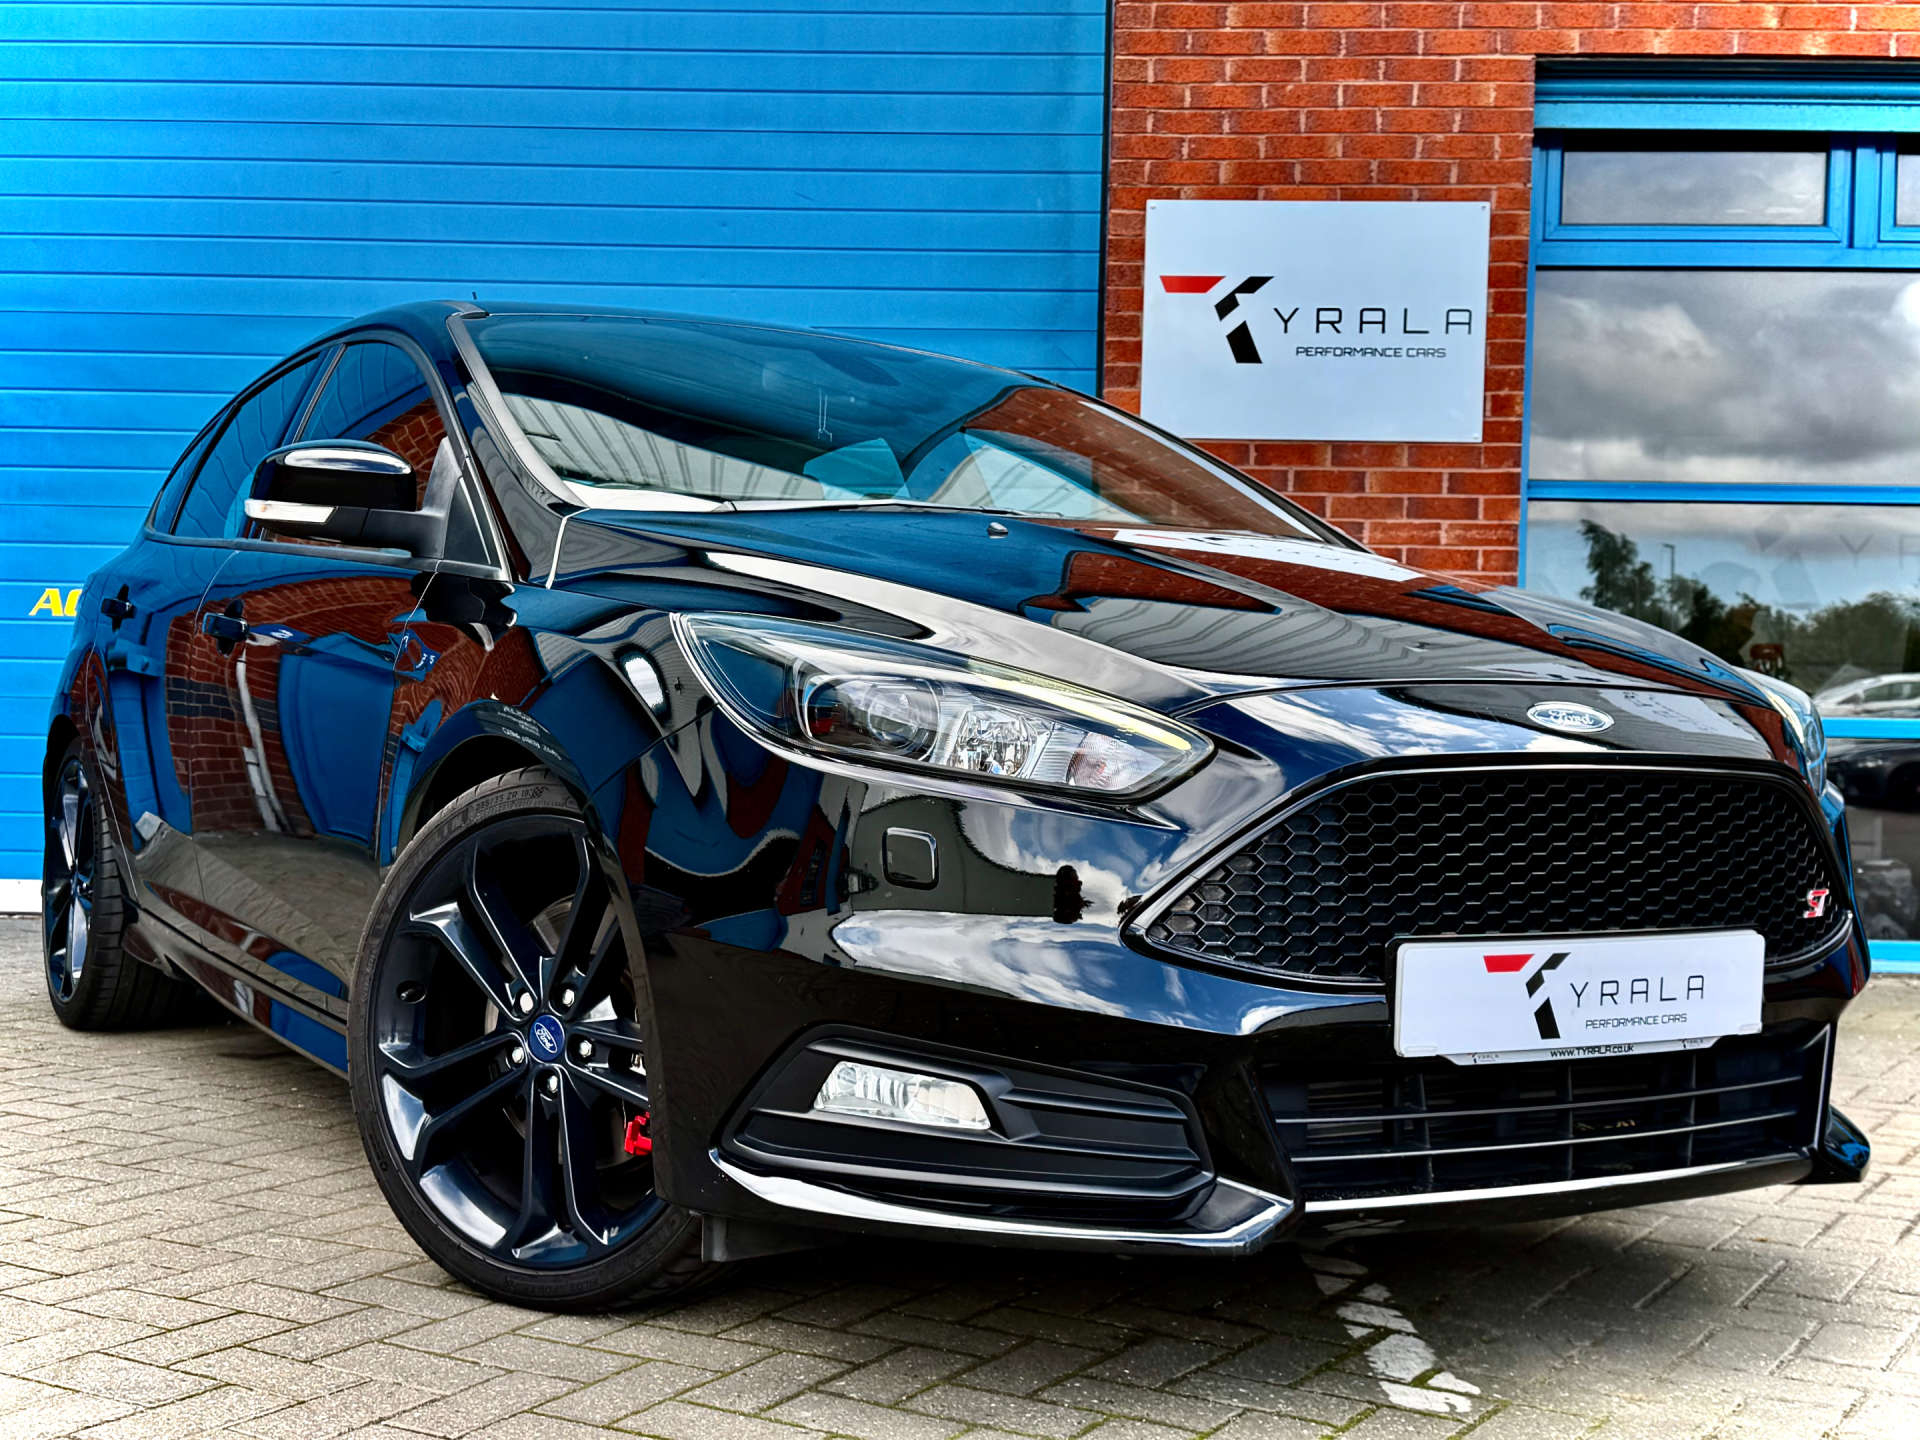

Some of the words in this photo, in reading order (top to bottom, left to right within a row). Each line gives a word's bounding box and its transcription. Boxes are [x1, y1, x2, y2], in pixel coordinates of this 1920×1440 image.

[1296, 346, 1403, 358] PERFORMANCE
[1406, 347, 1447, 358] CARS
[1585, 1015, 1659, 1029] PERFORMANCE
[1661, 1013, 1687, 1025] CARS
